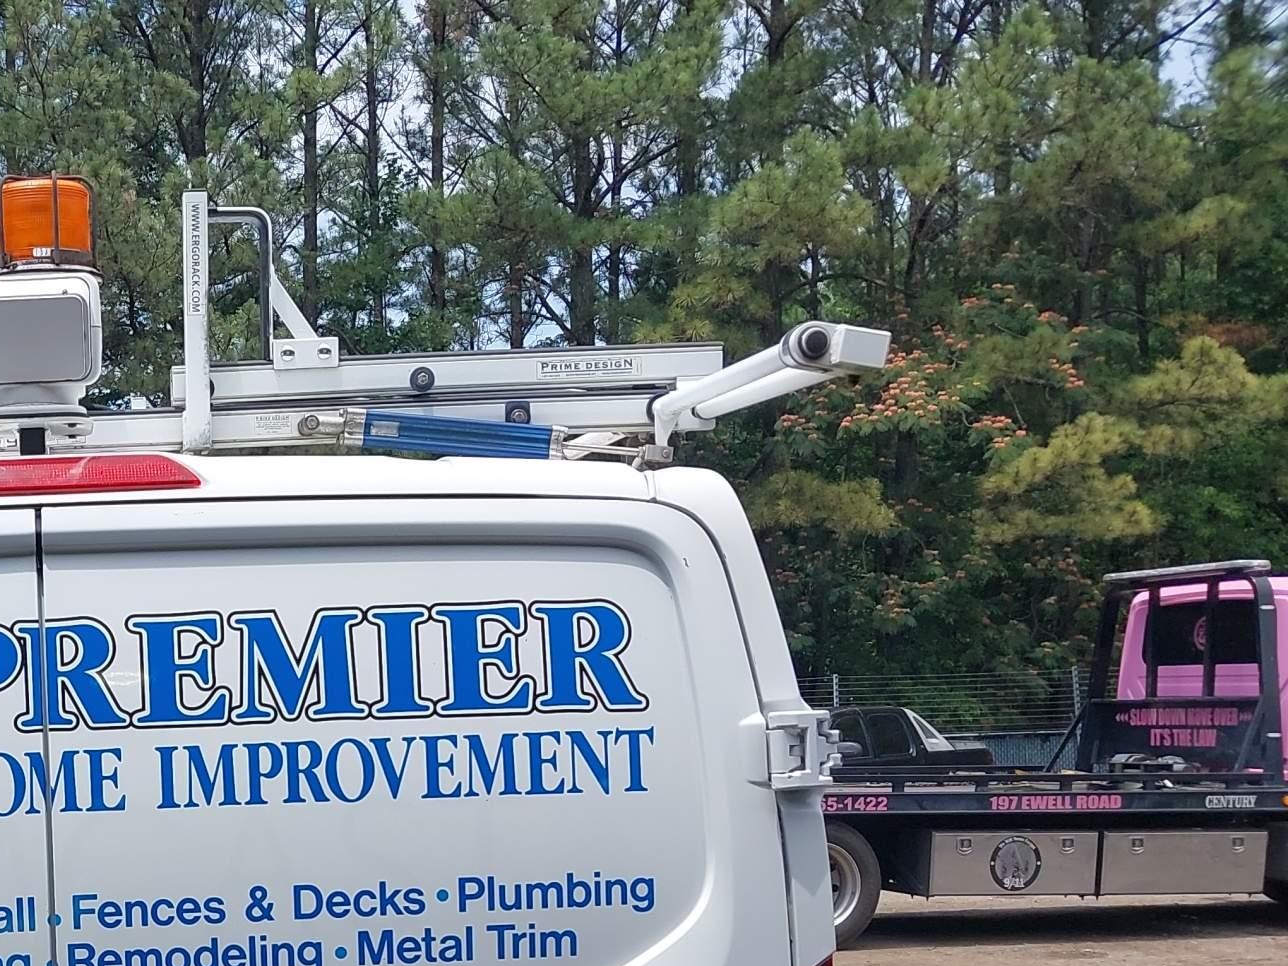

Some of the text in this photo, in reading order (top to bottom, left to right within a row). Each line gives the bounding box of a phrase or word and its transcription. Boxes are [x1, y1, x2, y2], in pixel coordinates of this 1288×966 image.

[191, 203, 201, 313] WWW.ERGORACK.COM
[540, 358, 633, 371] PRIME DESIGN
[1130, 708, 1157, 726] SLOW
[1150, 728, 1217, 747] IT'S THE LAW
[154, 726, 654, 809] IMPROVEMENT
[990, 795, 1122, 810] 197 EWELL ROAD
[1205, 795, 1258, 808] CENTURY
[1003, 876, 1025, 889] 9/11
[71, 893, 227, 929] Fences
[245, 885, 275, 923] &
[293, 881, 426, 920] Decks
[458, 871, 655, 913] Plumbing
[357, 926, 473, 966] Metal
[487, 923, 577, 960] Trim
